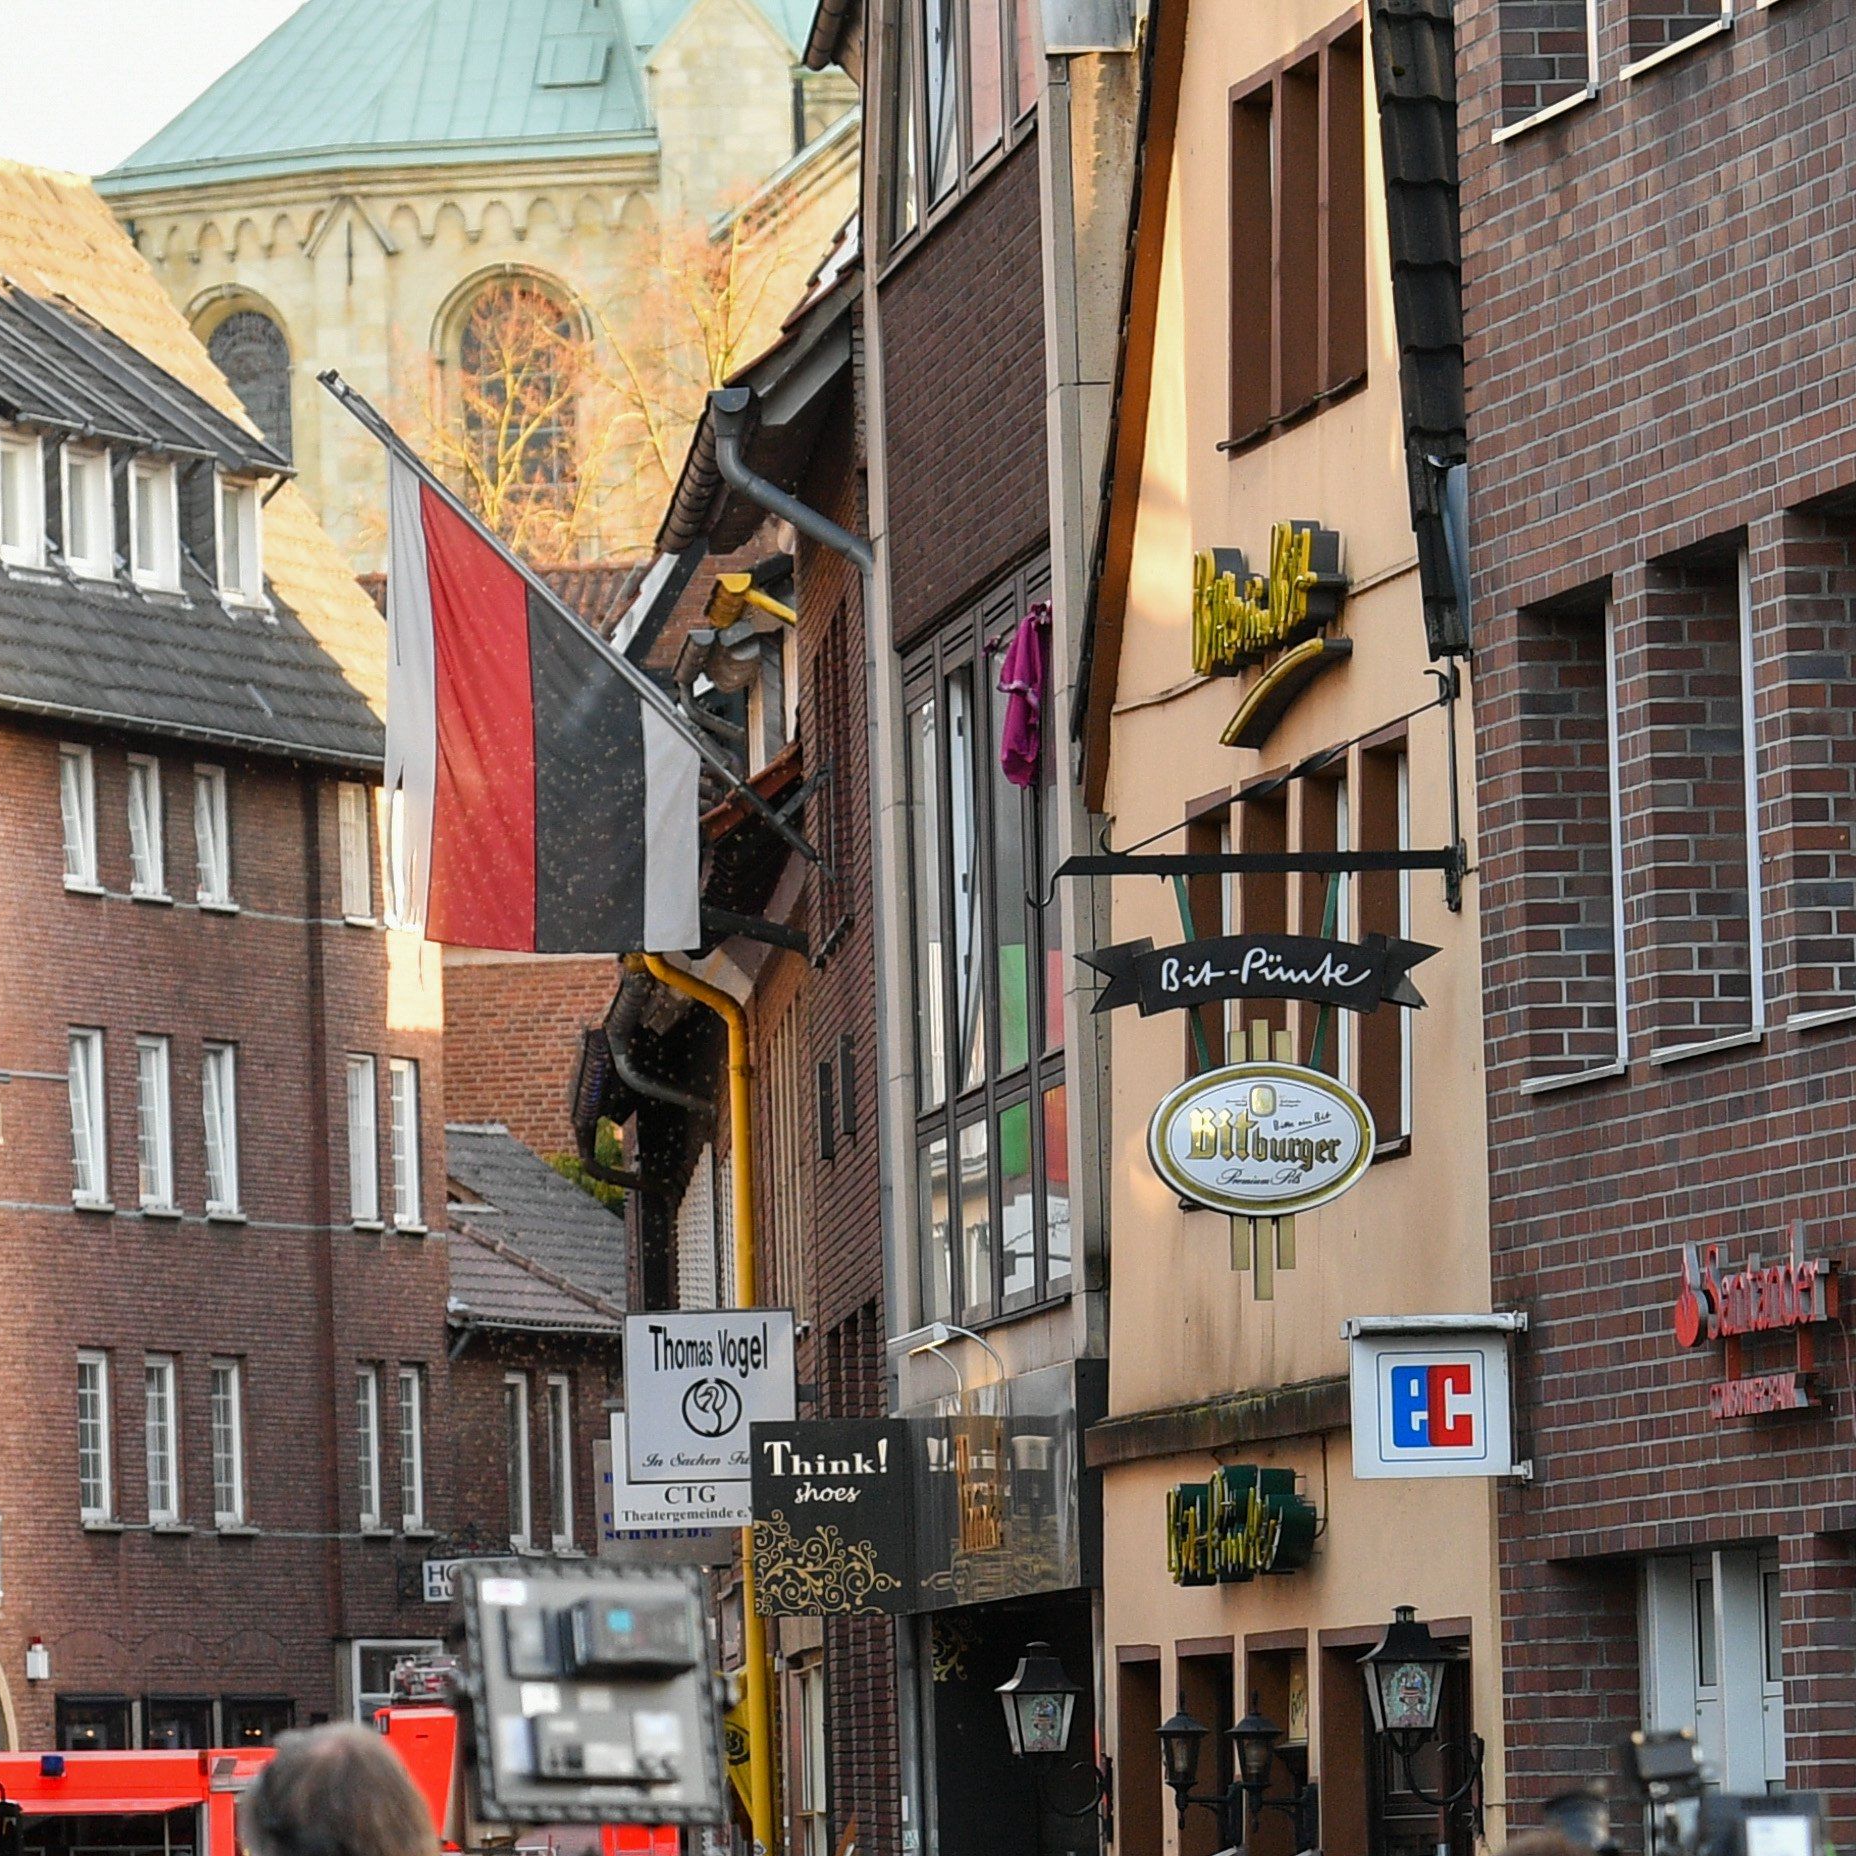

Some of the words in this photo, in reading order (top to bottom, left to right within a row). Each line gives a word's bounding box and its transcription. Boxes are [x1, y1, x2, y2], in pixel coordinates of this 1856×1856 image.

[1161, 947, 1372, 992] Bit-Pünte
[1185, 1107, 1343, 1173] Bitburger
[1216, 1167, 1270, 1186] Premium
[1271, 1167, 1303, 1185] Pils
[649, 1324, 713, 1372] Thomas
[717, 1321, 768, 1379] Vogel
[642, 1452, 664, 1468] In
[669, 1451, 721, 1468] Sachen
[763, 1437, 888, 1477] Think!
[664, 1484, 716, 1505] CTG
[794, 1482, 862, 1504] shoes
[622, 1506, 734, 1523] Theatergemeinde
